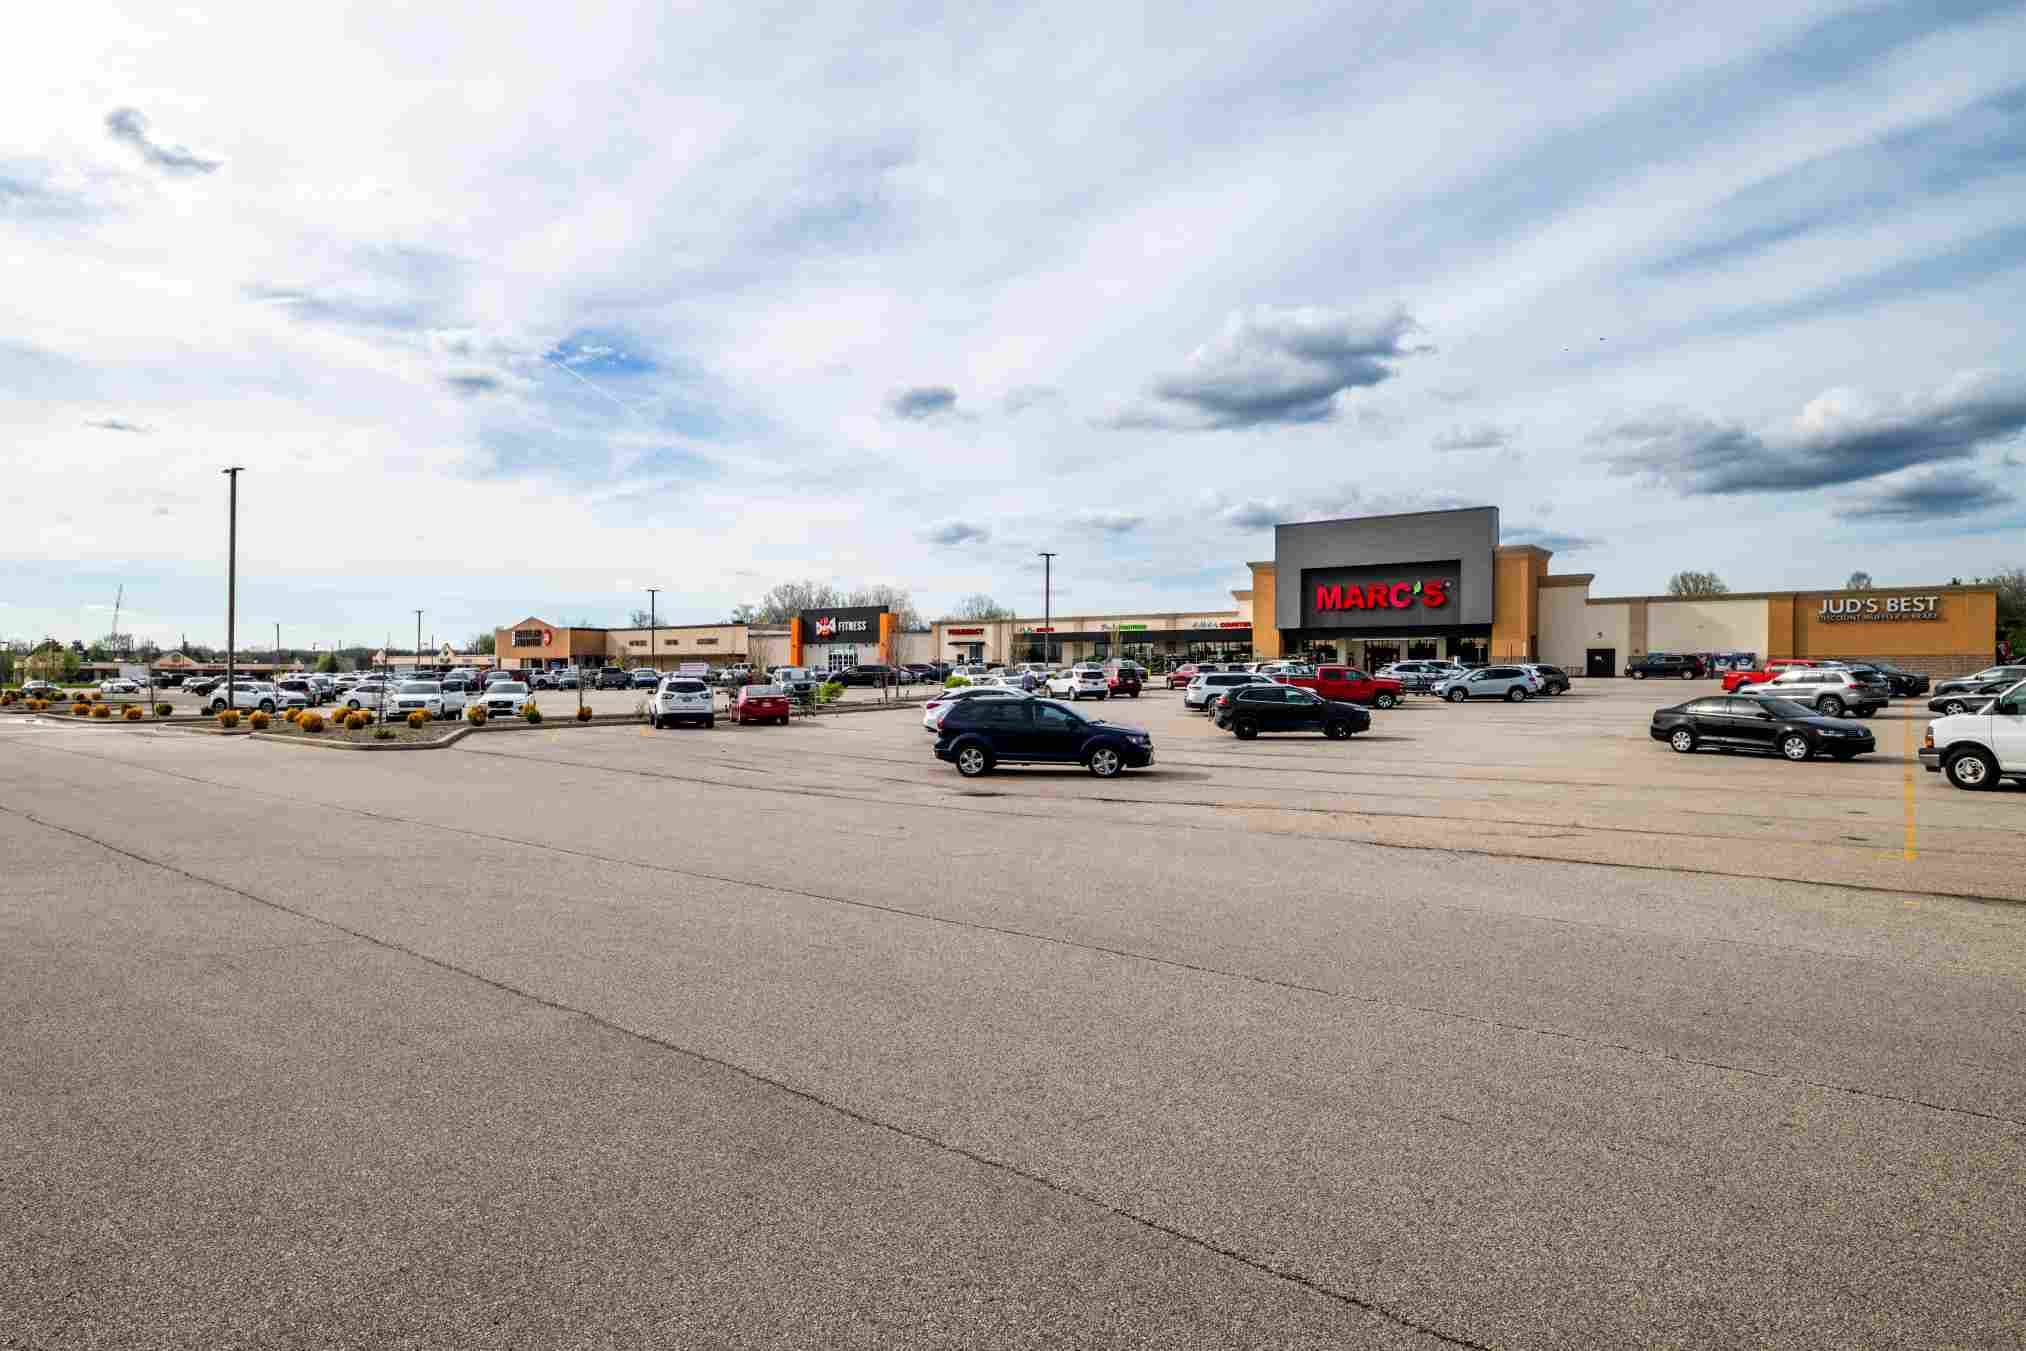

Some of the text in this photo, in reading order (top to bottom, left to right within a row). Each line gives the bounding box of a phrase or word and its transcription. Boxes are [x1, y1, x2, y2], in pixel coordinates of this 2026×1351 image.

[1315, 580, 1448, 609] MARC'S
[1818, 596, 1939, 614] JUD'S BEST
[838, 620, 867, 633] FITNESS
